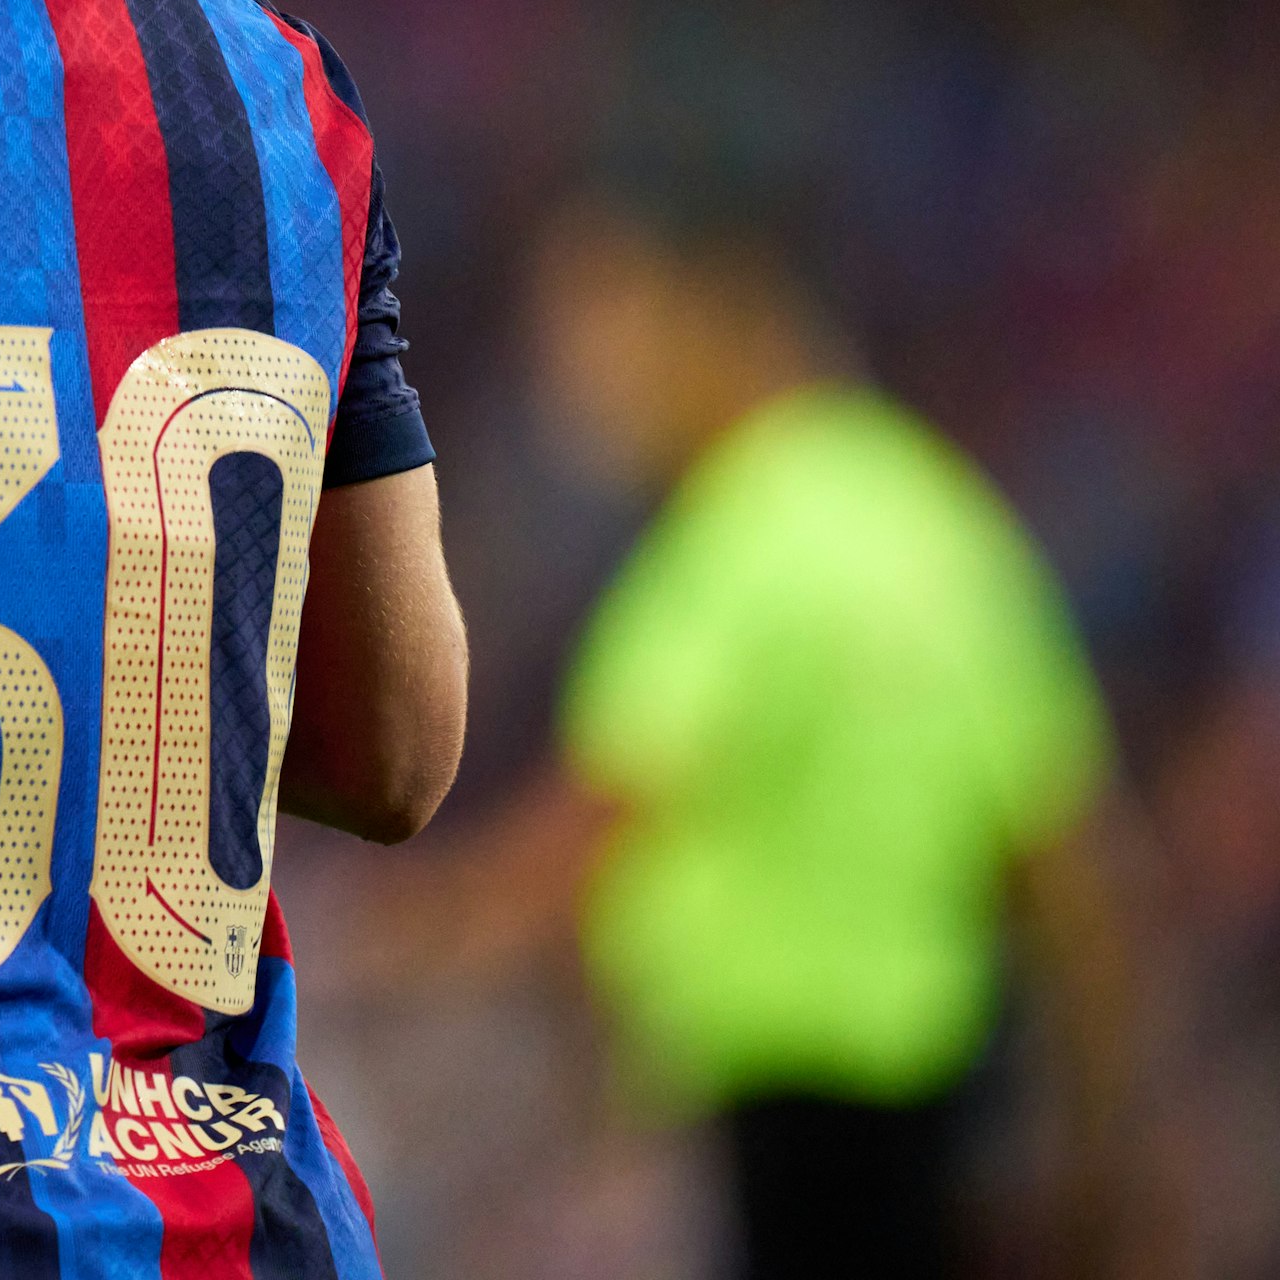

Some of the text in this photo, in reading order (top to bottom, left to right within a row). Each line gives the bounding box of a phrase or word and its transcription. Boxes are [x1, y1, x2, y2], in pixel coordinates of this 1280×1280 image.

[88, 1053, 260, 1122] UNHCR
[88, 1097, 286, 1161] ACNUR
[95, 1161, 127, 1177] The
[127, 1163, 157, 1178] UN
[158, 1152, 236, 1177] Refugee
